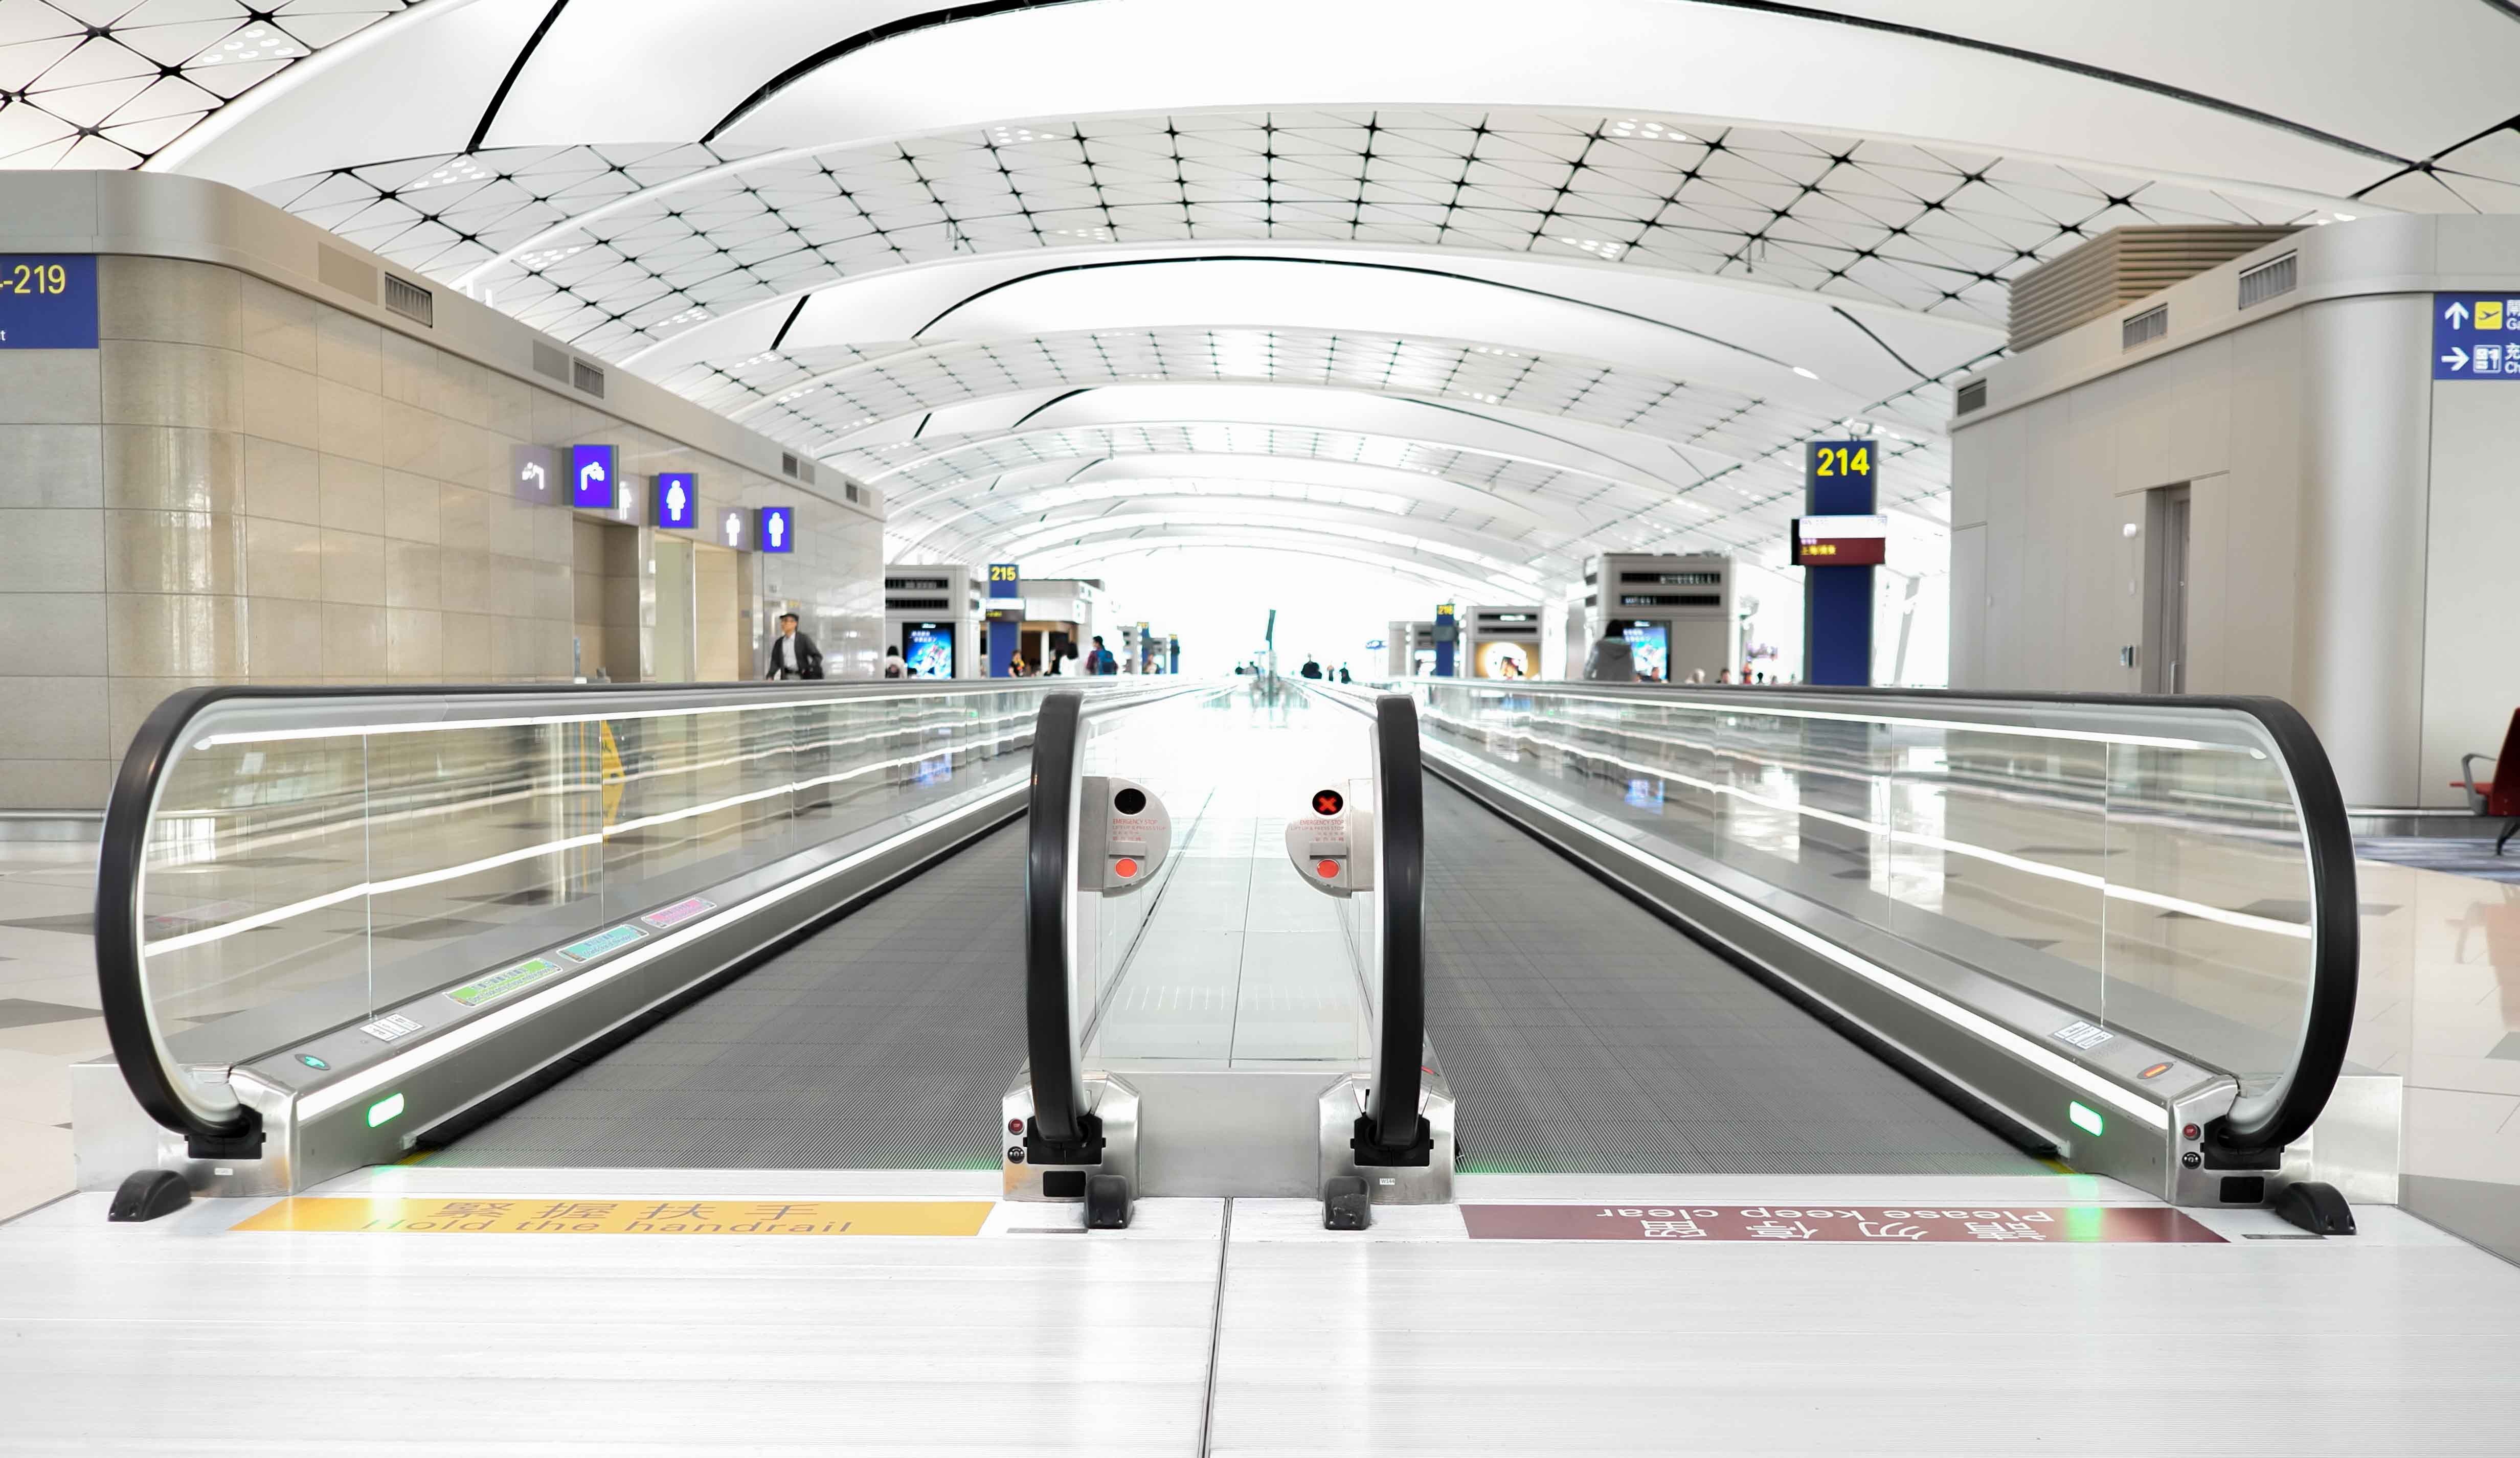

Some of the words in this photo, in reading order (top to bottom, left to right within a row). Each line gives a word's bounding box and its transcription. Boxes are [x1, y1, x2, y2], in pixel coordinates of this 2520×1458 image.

[0, 264, 65, 294] -219
[1817, 448, 1870, 476] 214
[991, 566, 1016, 581] 215
[427, 1202, 819, 1220] 緊握扶手
[1596, 1209, 1719, 1220] clear
[1740, 1208, 1865, 1221] keep
[1883, 1210, 2055, 1222] Please
[361, 1220, 495, 1231] Hold
[515, 1220, 599, 1231] the
[624, 1221, 852, 1232] handrail
[1640, 1220, 2046, 1240] 請勿停留
